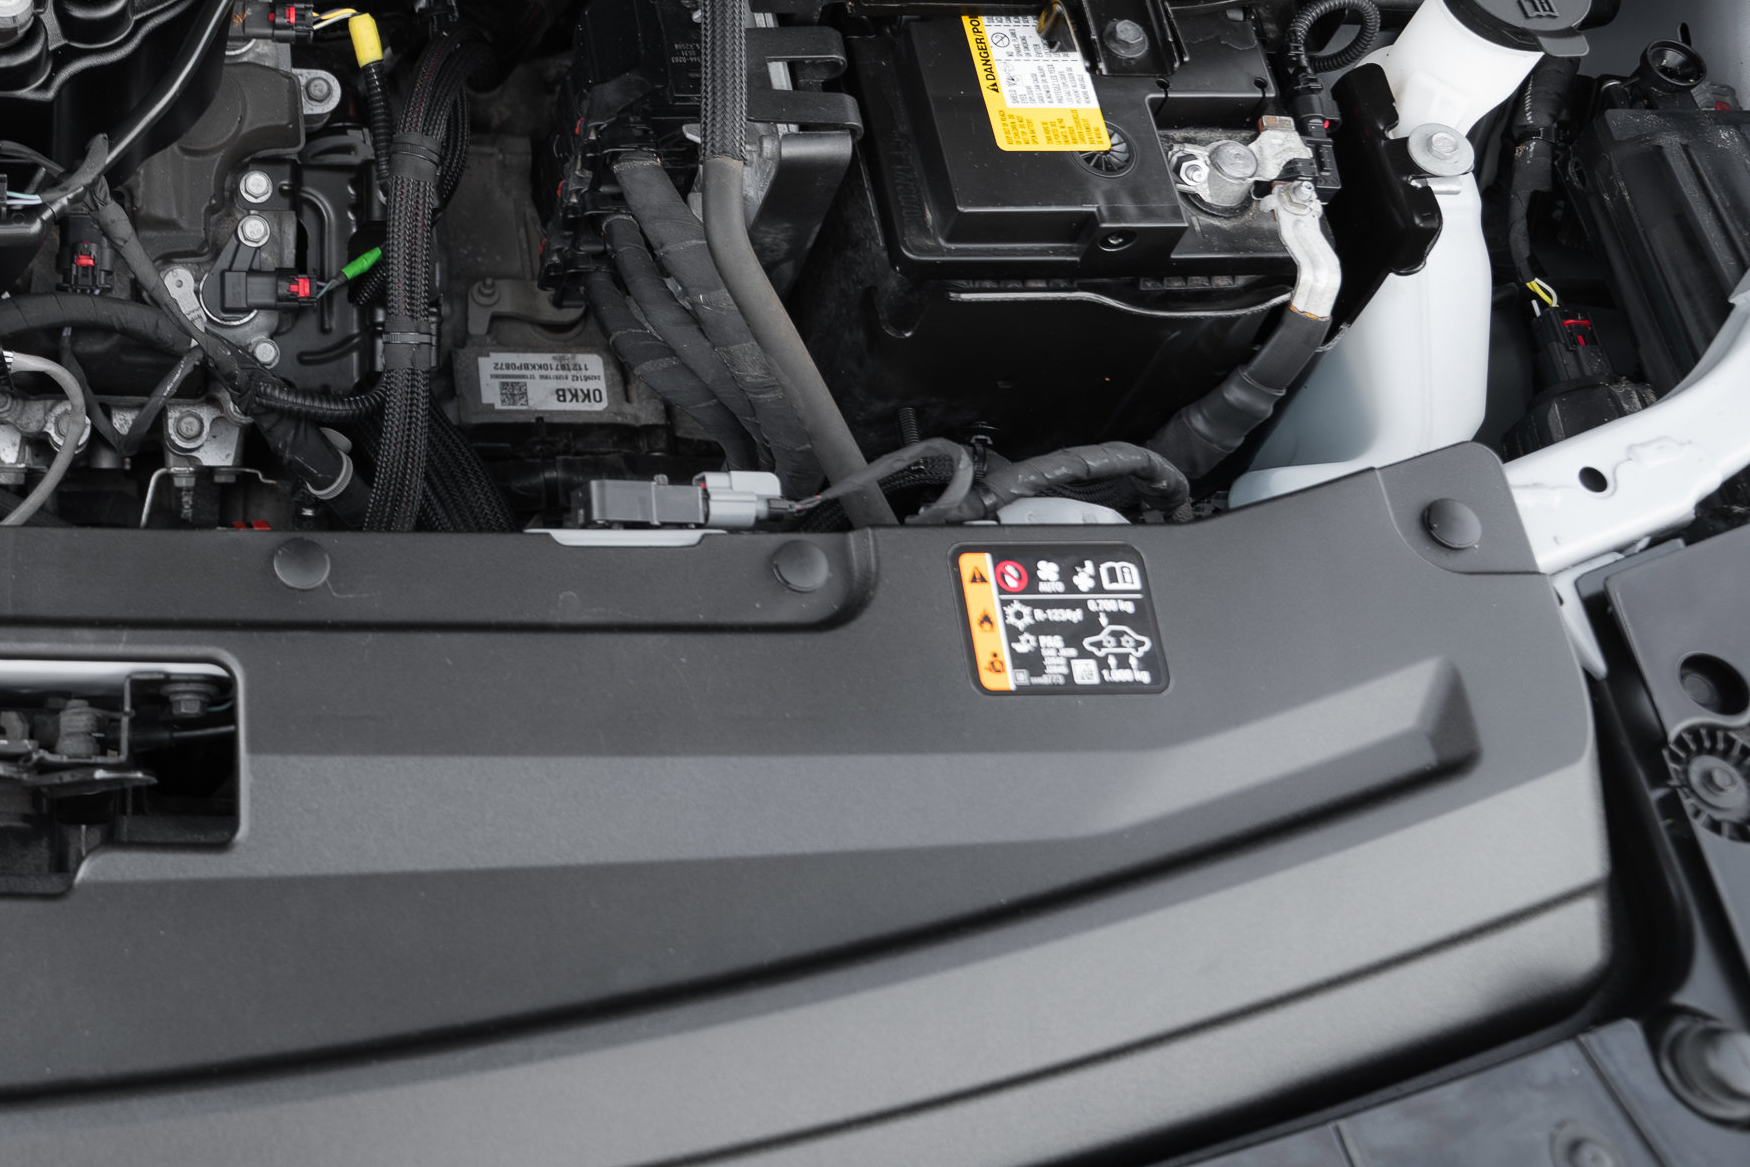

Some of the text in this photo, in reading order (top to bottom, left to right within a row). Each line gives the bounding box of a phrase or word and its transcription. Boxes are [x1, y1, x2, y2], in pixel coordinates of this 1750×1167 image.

[970, 16, 996, 80] DANGER/POI
[1038, 582, 1065, 593] AUTO
[1087, 600, 1135, 613] 0.700 kg
[1034, 609, 1084, 623] R-1234yf
[1039, 636, 1064, 648] PAG
[1133, 670, 1151, 684] kg
